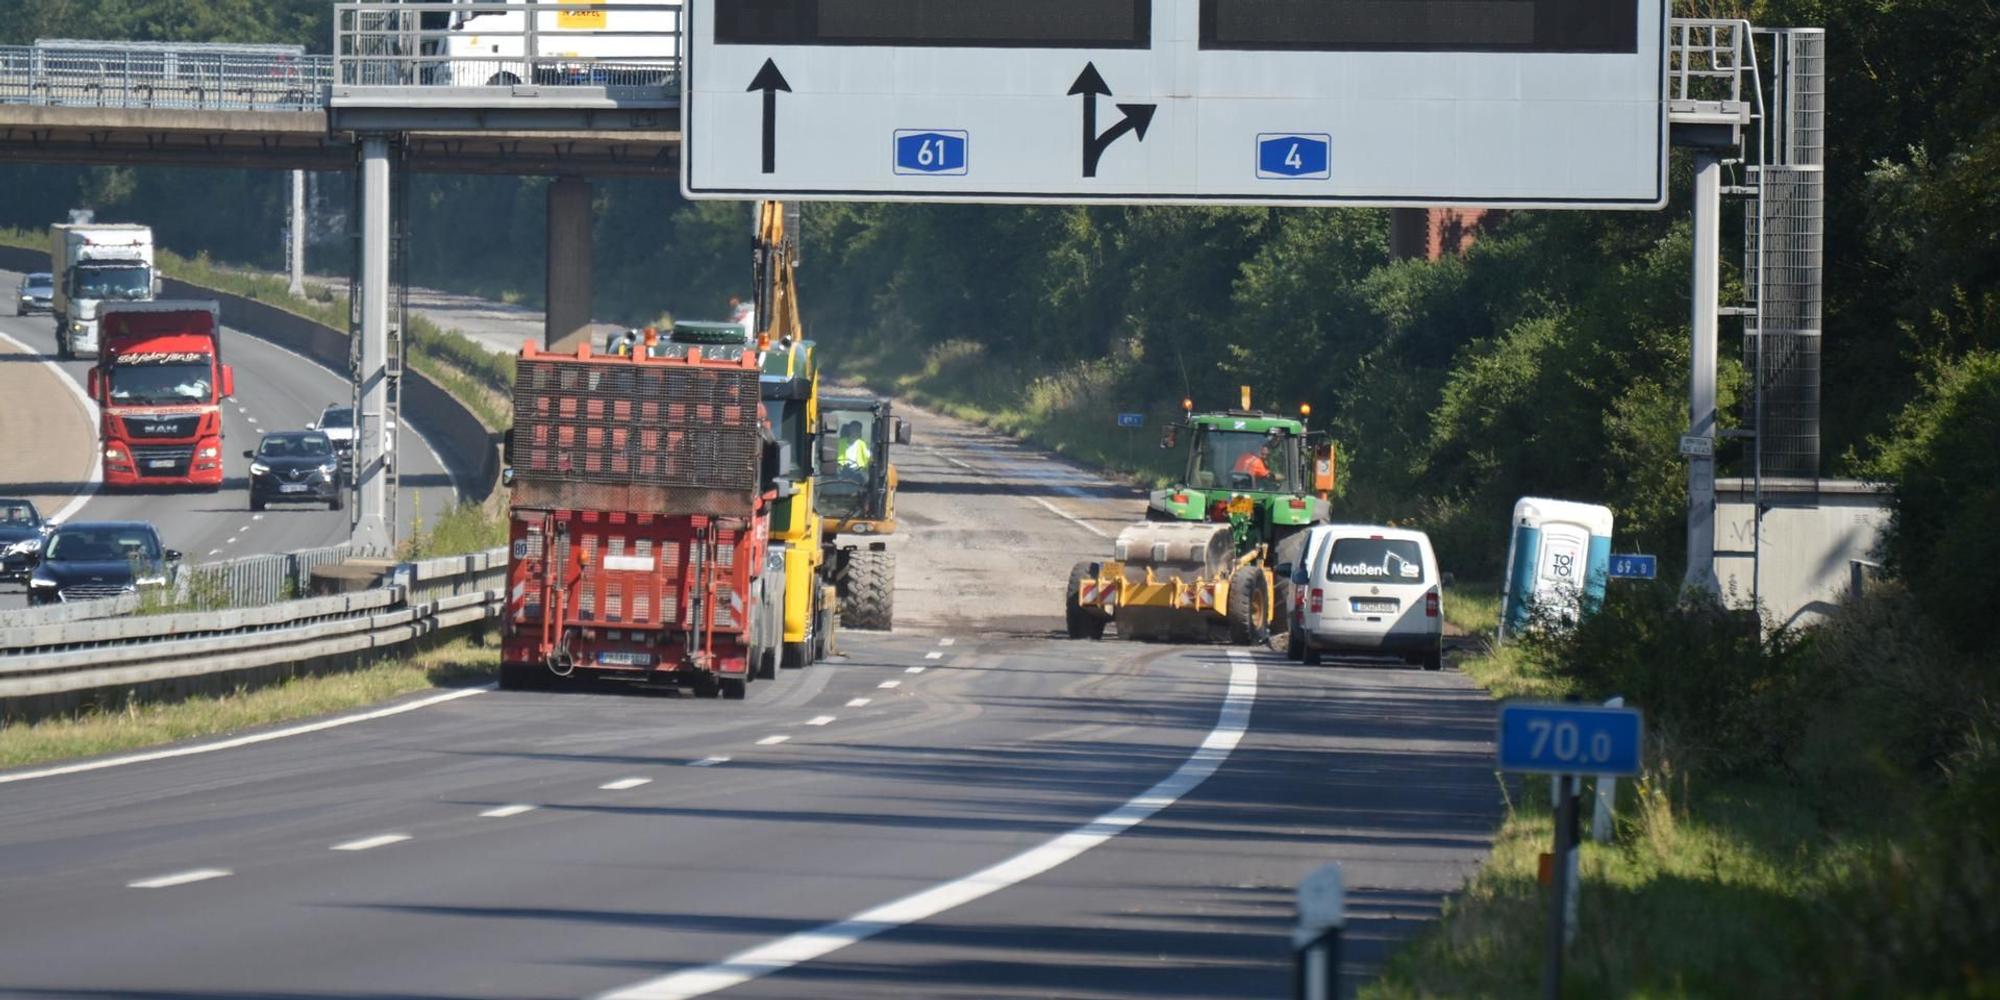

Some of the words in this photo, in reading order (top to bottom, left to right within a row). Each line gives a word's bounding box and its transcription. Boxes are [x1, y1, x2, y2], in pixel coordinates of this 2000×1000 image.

[917, 139, 944, 166] 61
[1284, 143, 1303, 169] 4
[144, 425, 178, 433] MAN
[515, 543, 527, 556] 80
[1331, 562, 1382, 576] Maaßen
[1527, 720, 1612, 763] 70.0
